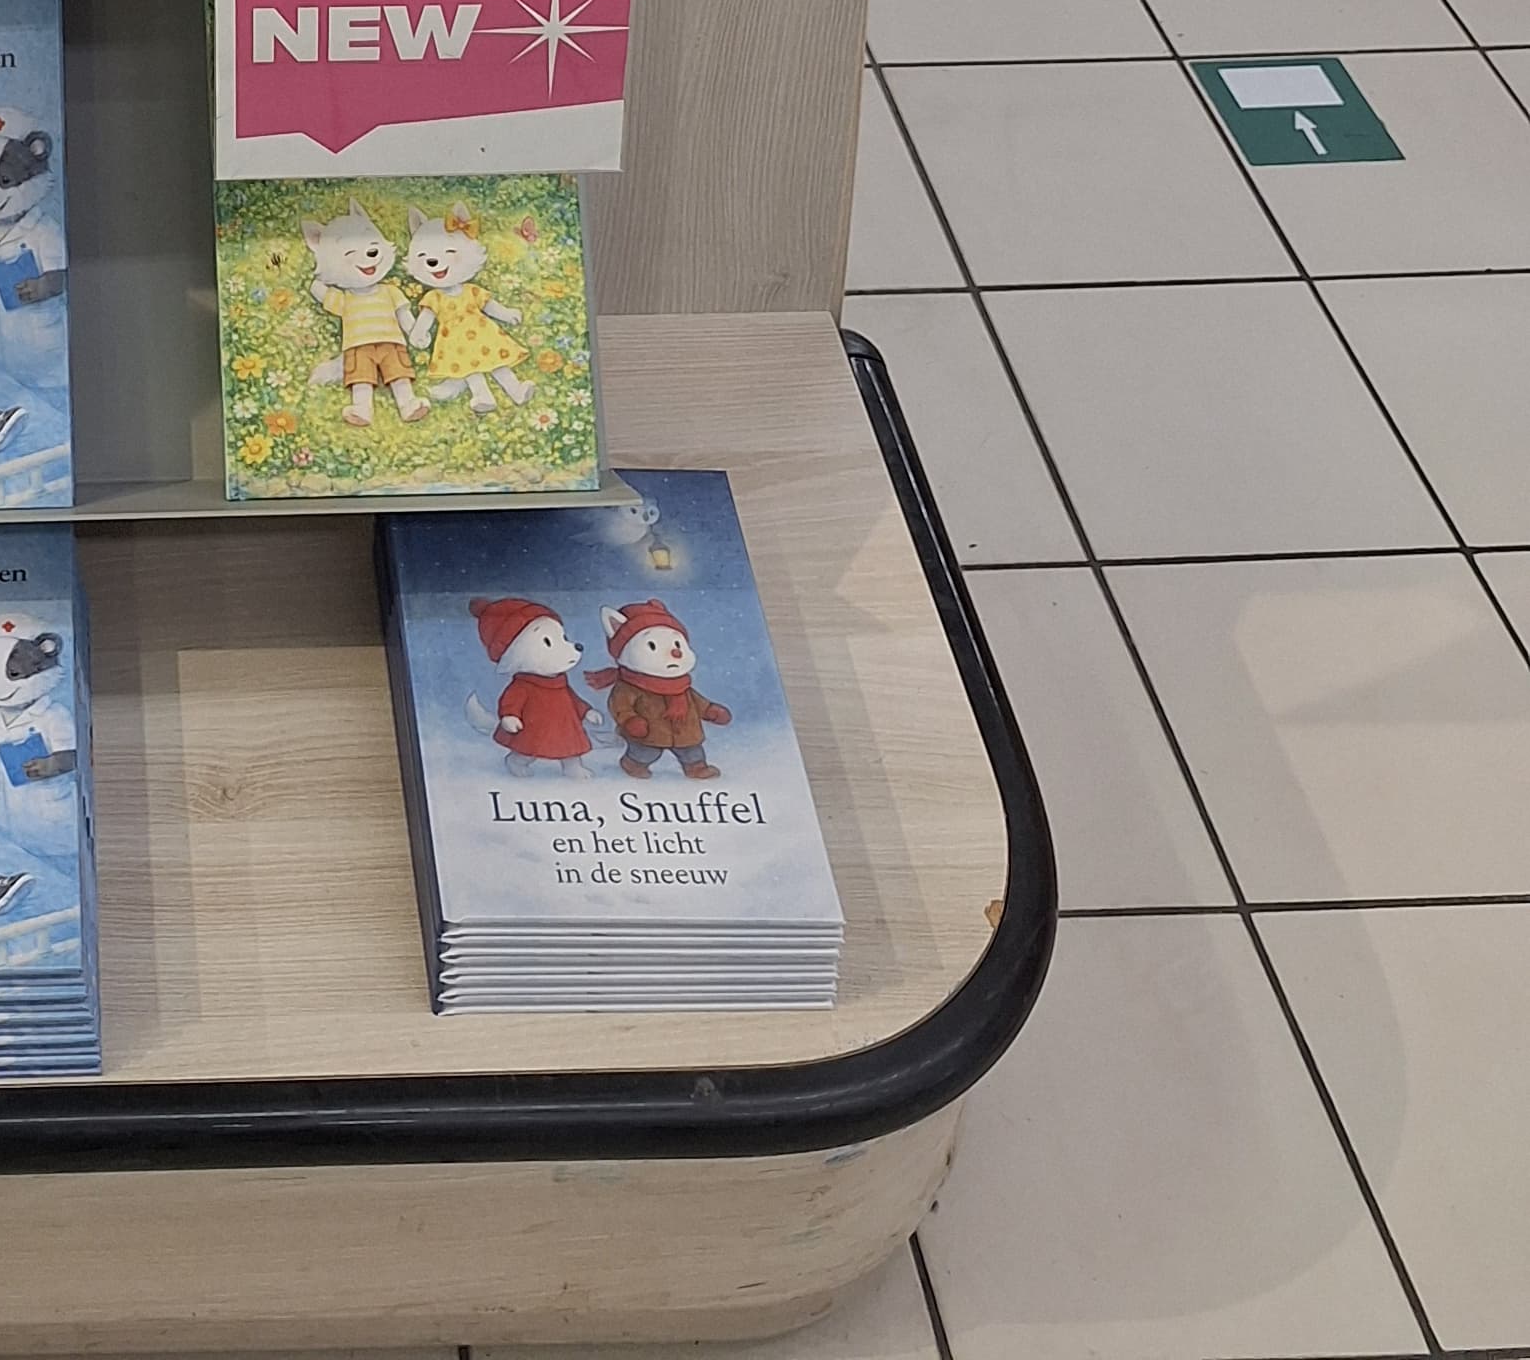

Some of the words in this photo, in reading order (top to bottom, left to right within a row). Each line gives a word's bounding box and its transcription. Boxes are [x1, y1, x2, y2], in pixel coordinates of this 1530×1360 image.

[252, 3, 482, 64] NEW
[488, 791, 606, 827] Luna,
[621, 791, 768, 824] Snuffel
[552, 836, 586, 853] en
[591, 833, 638, 854] het
[645, 831, 707, 855] licht
[555, 863, 584, 885] in
[590, 862, 622, 885] de
[629, 865, 728, 885] sneeuw
